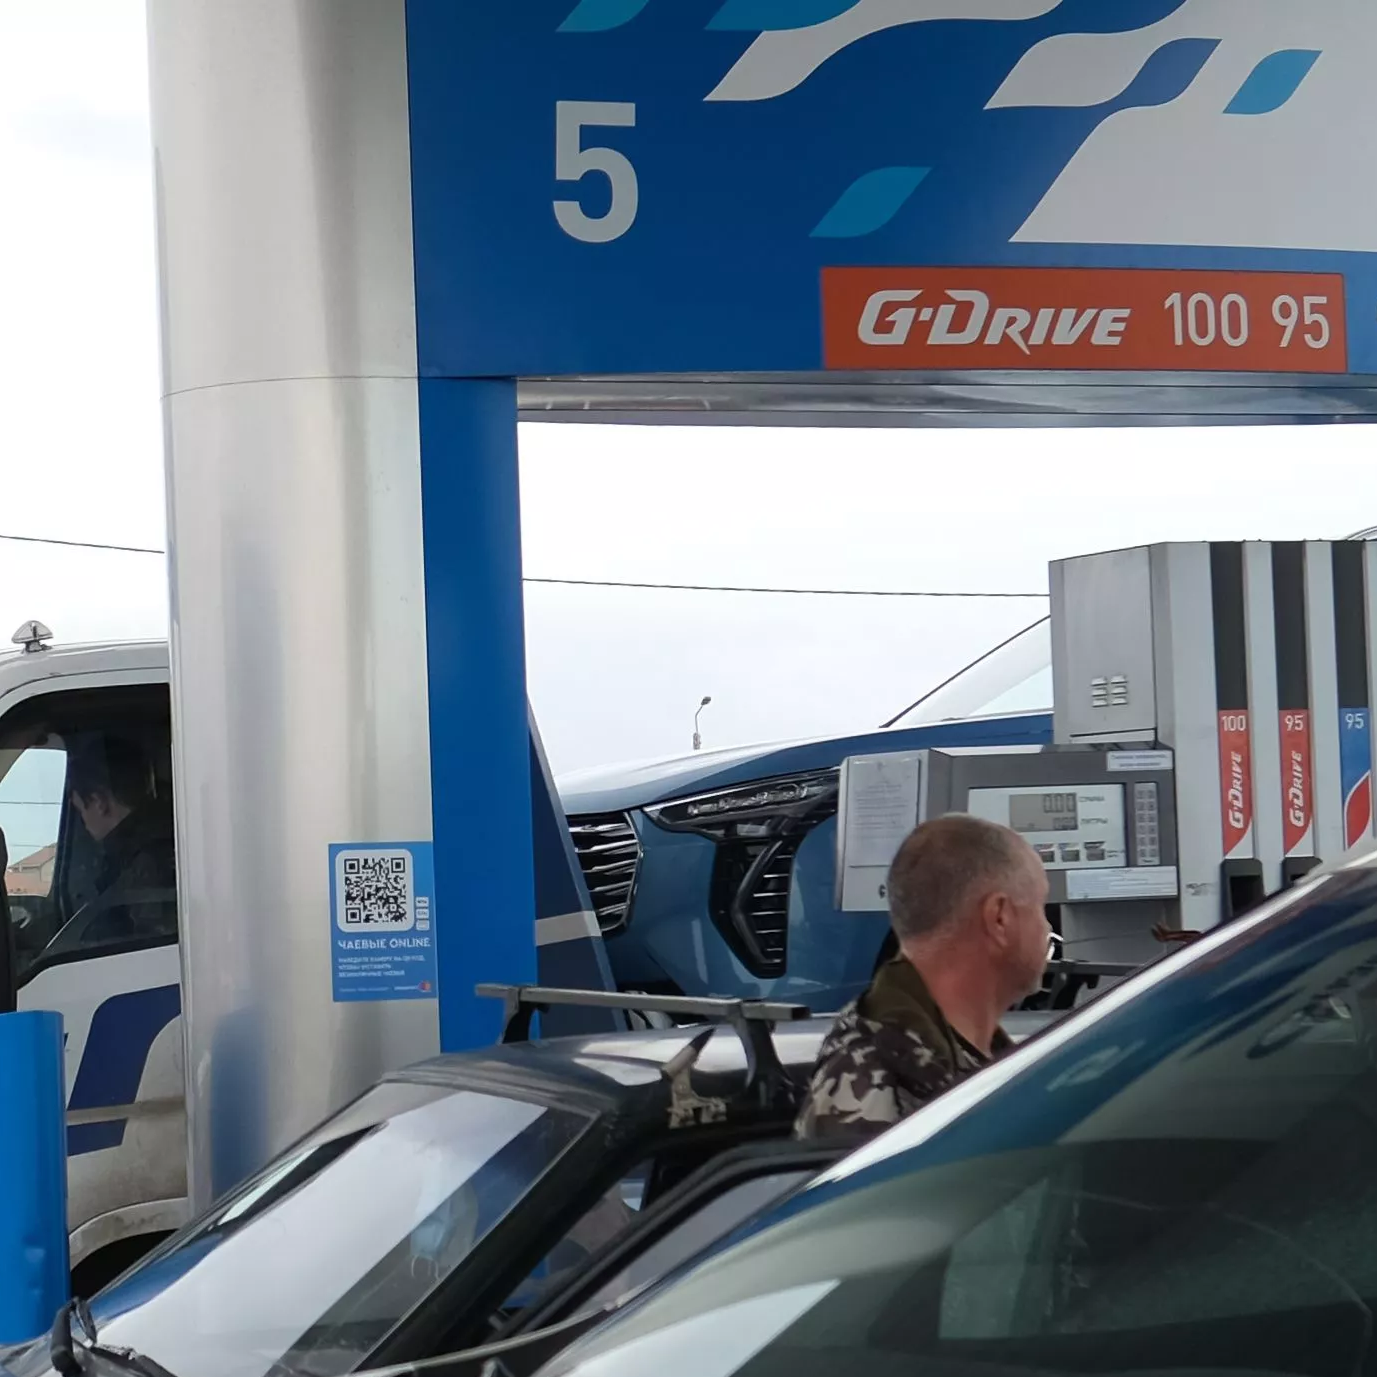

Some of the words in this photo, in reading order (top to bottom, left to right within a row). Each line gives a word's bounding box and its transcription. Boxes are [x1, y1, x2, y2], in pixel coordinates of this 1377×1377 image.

[553, 100, 639, 243] 5
[1164, 291, 1249, 348] 100
[1272, 294, 1331, 349] 95
[1222, 715, 1247, 732] 100
[1285, 714, 1304, 731] 95
[1345, 713, 1364, 730] 95
[337, 938, 387, 950] ЧАЕВЫЕ
[389, 937, 431, 949] ONLINE
